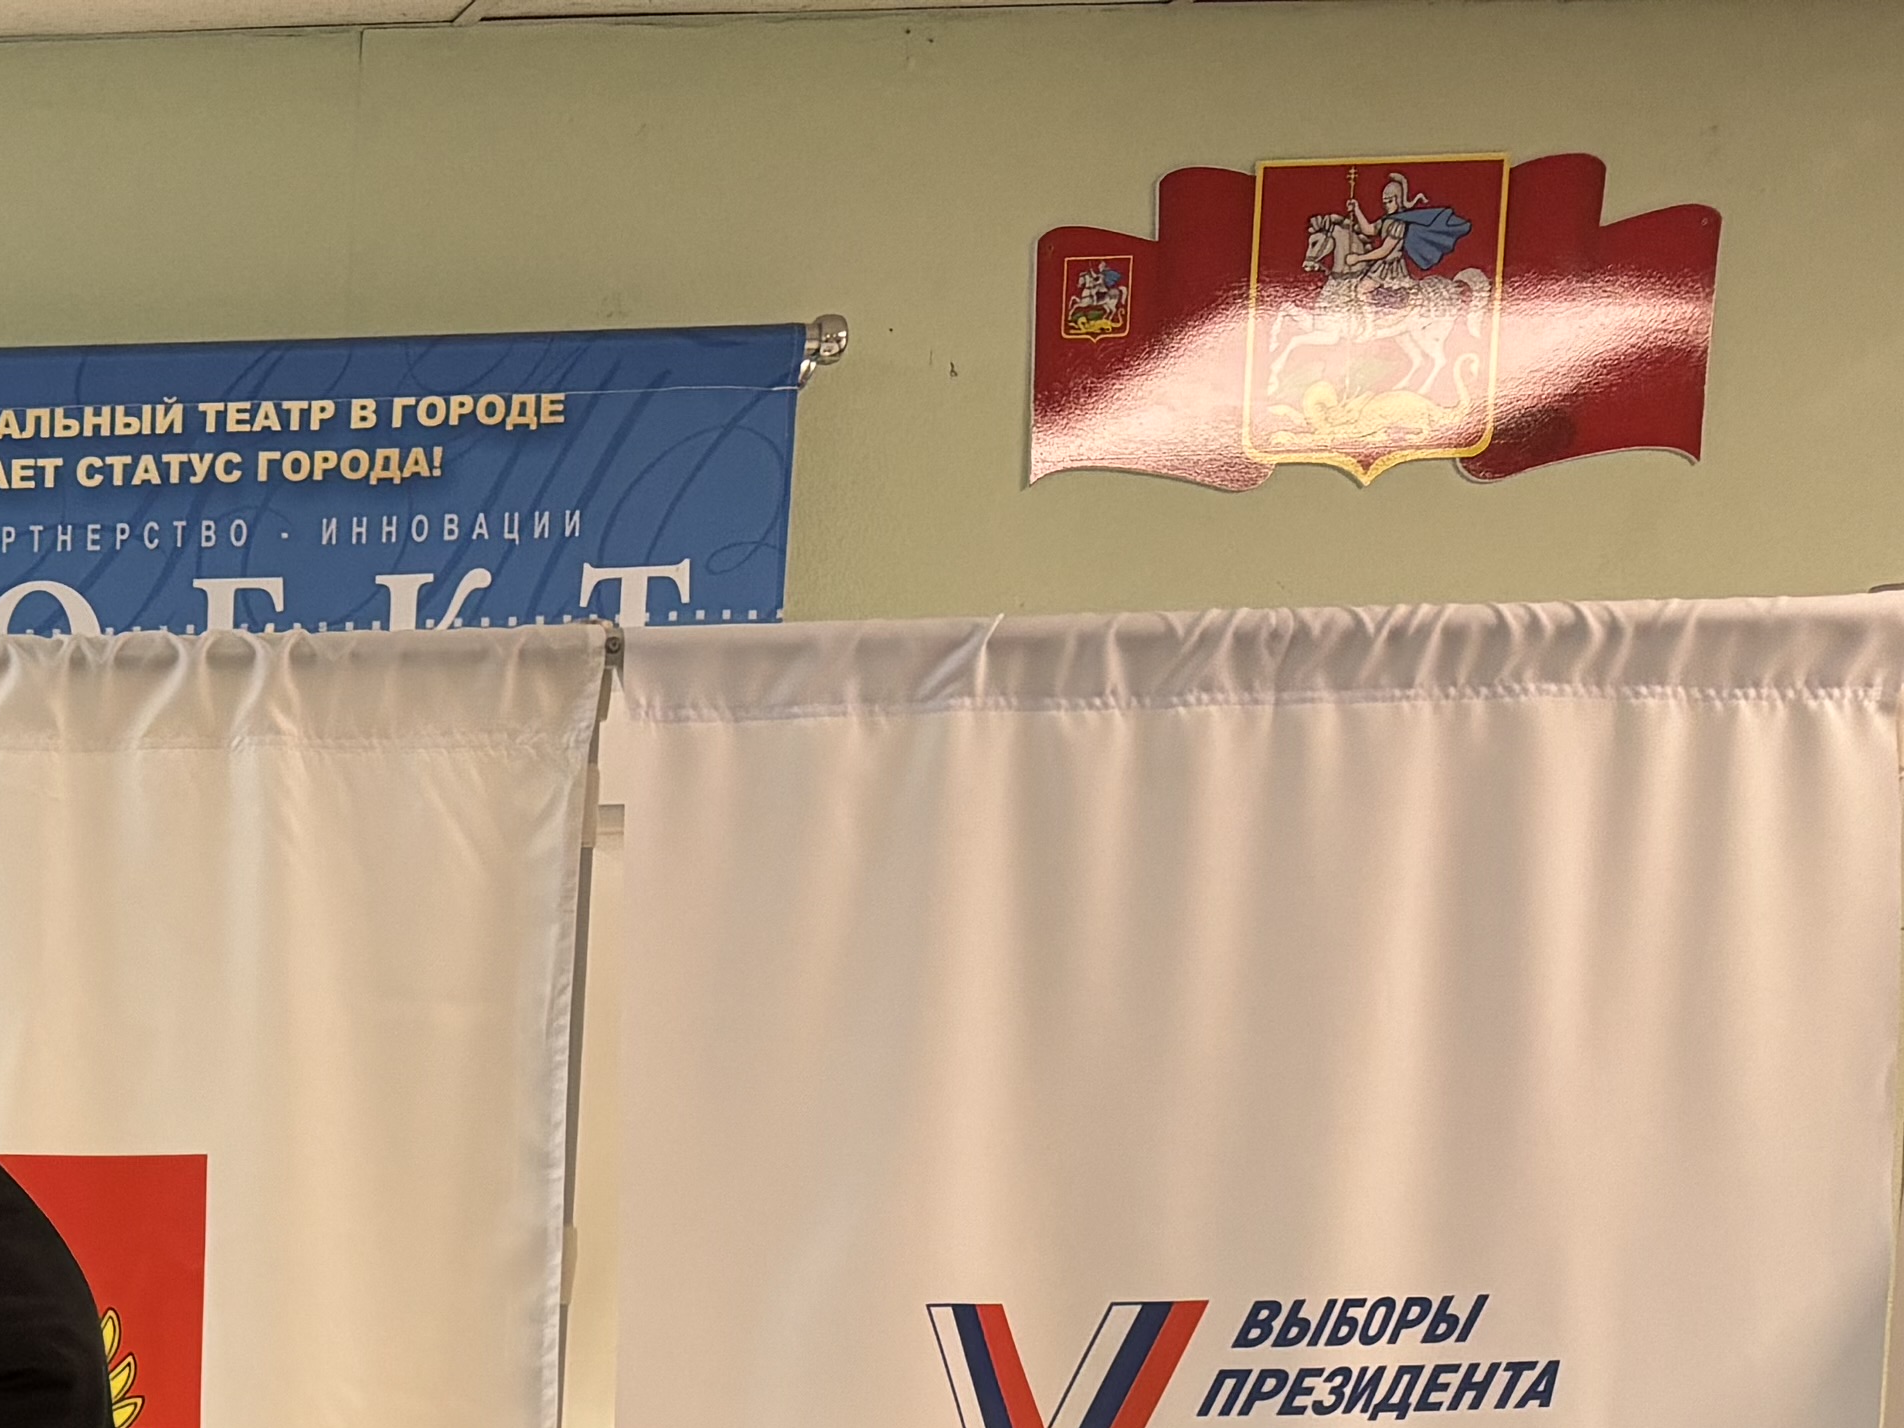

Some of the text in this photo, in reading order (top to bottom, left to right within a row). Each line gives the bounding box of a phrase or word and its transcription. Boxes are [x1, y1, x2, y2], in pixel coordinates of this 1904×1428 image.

[198, 400, 335, 432] ТЕАТР
[350, 399, 376, 429] В
[392, 393, 565, 430] ГОРОДЕ
[77, 452, 241, 487] СТАТУС
[258, 447, 442, 484] ГОРОДА!
[322, 510, 580, 545] ИННОВАЦИИ
[1232, 1295, 1489, 1348] ВЫБОРЫ
[1197, 1360, 1560, 1420] ПРЕЗИДЕНТА
